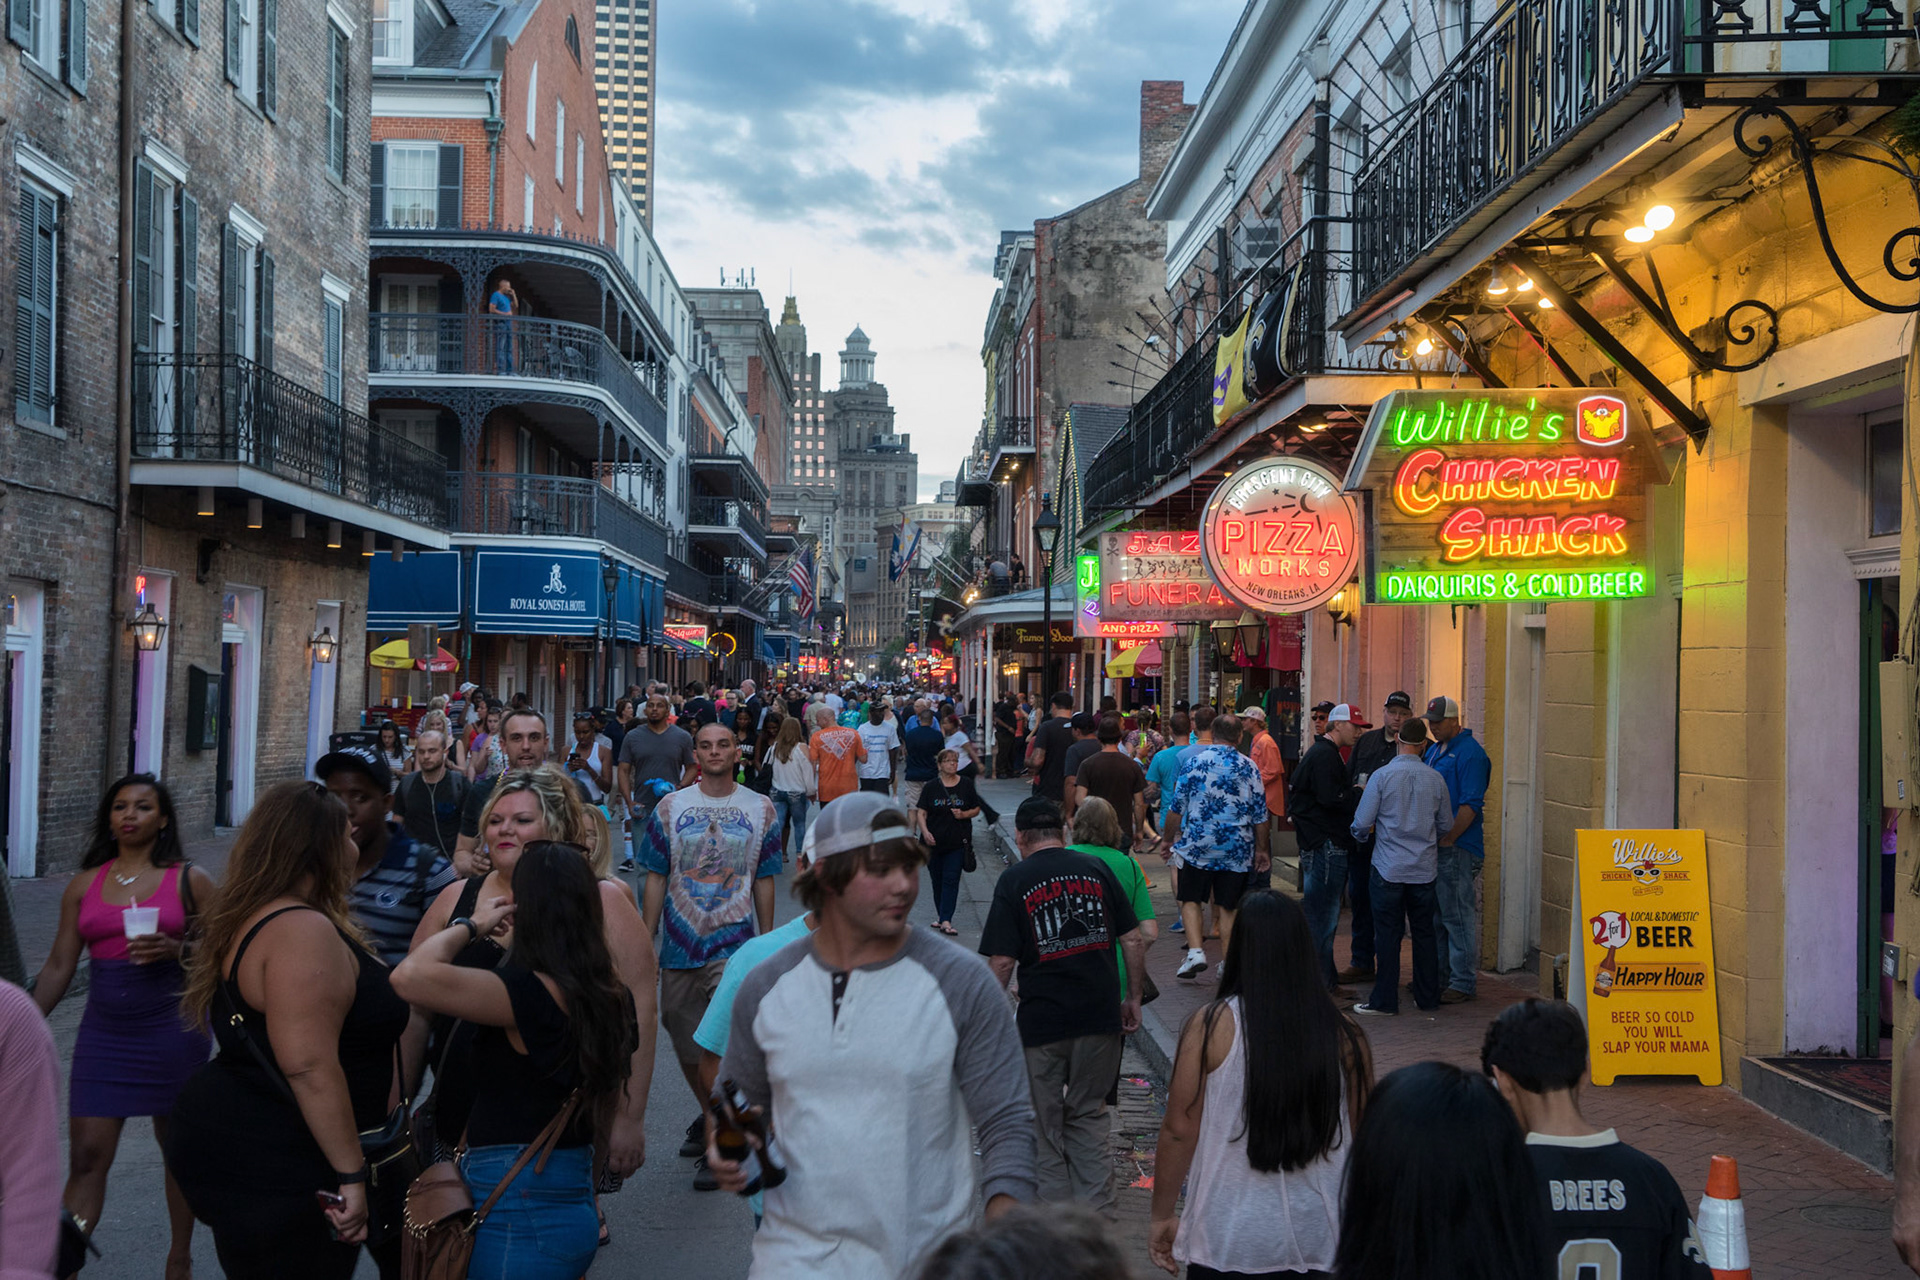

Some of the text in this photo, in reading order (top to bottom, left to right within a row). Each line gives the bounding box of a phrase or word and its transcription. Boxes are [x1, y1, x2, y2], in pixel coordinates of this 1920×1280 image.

[1393, 397, 1565, 446] Willie's
[1227, 468, 1332, 511] CRESCENT CITY
[1395, 449, 1621, 516] CHICKEN
[823, 516, 831, 552] ASTOR
[1127, 533, 1200, 555] JAZ
[1222, 520, 1346, 556] PIZZA
[1440, 507, 1628, 563] SHACK
[1236, 558, 1331, 577] WORKS
[1246, 582, 1265, 597] NEW
[1309, 582, 1321, 595] LA
[1387, 572, 1645, 599] DAIQUIRIS & COLD BEER
[510, 598, 587, 612] ROYAL SONESTA HOTEL
[1015, 628, 1045, 644] Famo
[1102, 624, 1161, 634] AND PIZZA
[1612, 838, 1684, 867] Willie's
[1601, 872, 1632, 880] CHICKEN
[1025, 882, 1063, 915] COLD
[1064, 879, 1104, 901] WAR
[1630, 911, 1700, 921] LOCAL & DOMESTIC
[1589, 912, 1627, 945] 2 for 1
[1635, 926, 1694, 948] BEER
[1614, 966, 1663, 986] HAPPY
[1664, 966, 1705, 986] HOUR
[1611, 1010, 1694, 1023] BEER SO COLD
[1623, 1026, 1683, 1038] YOU WILL
[1602, 1040, 1710, 1053] SLAP YOUR MAMA
[1549, 1178, 1627, 1211] BREES
